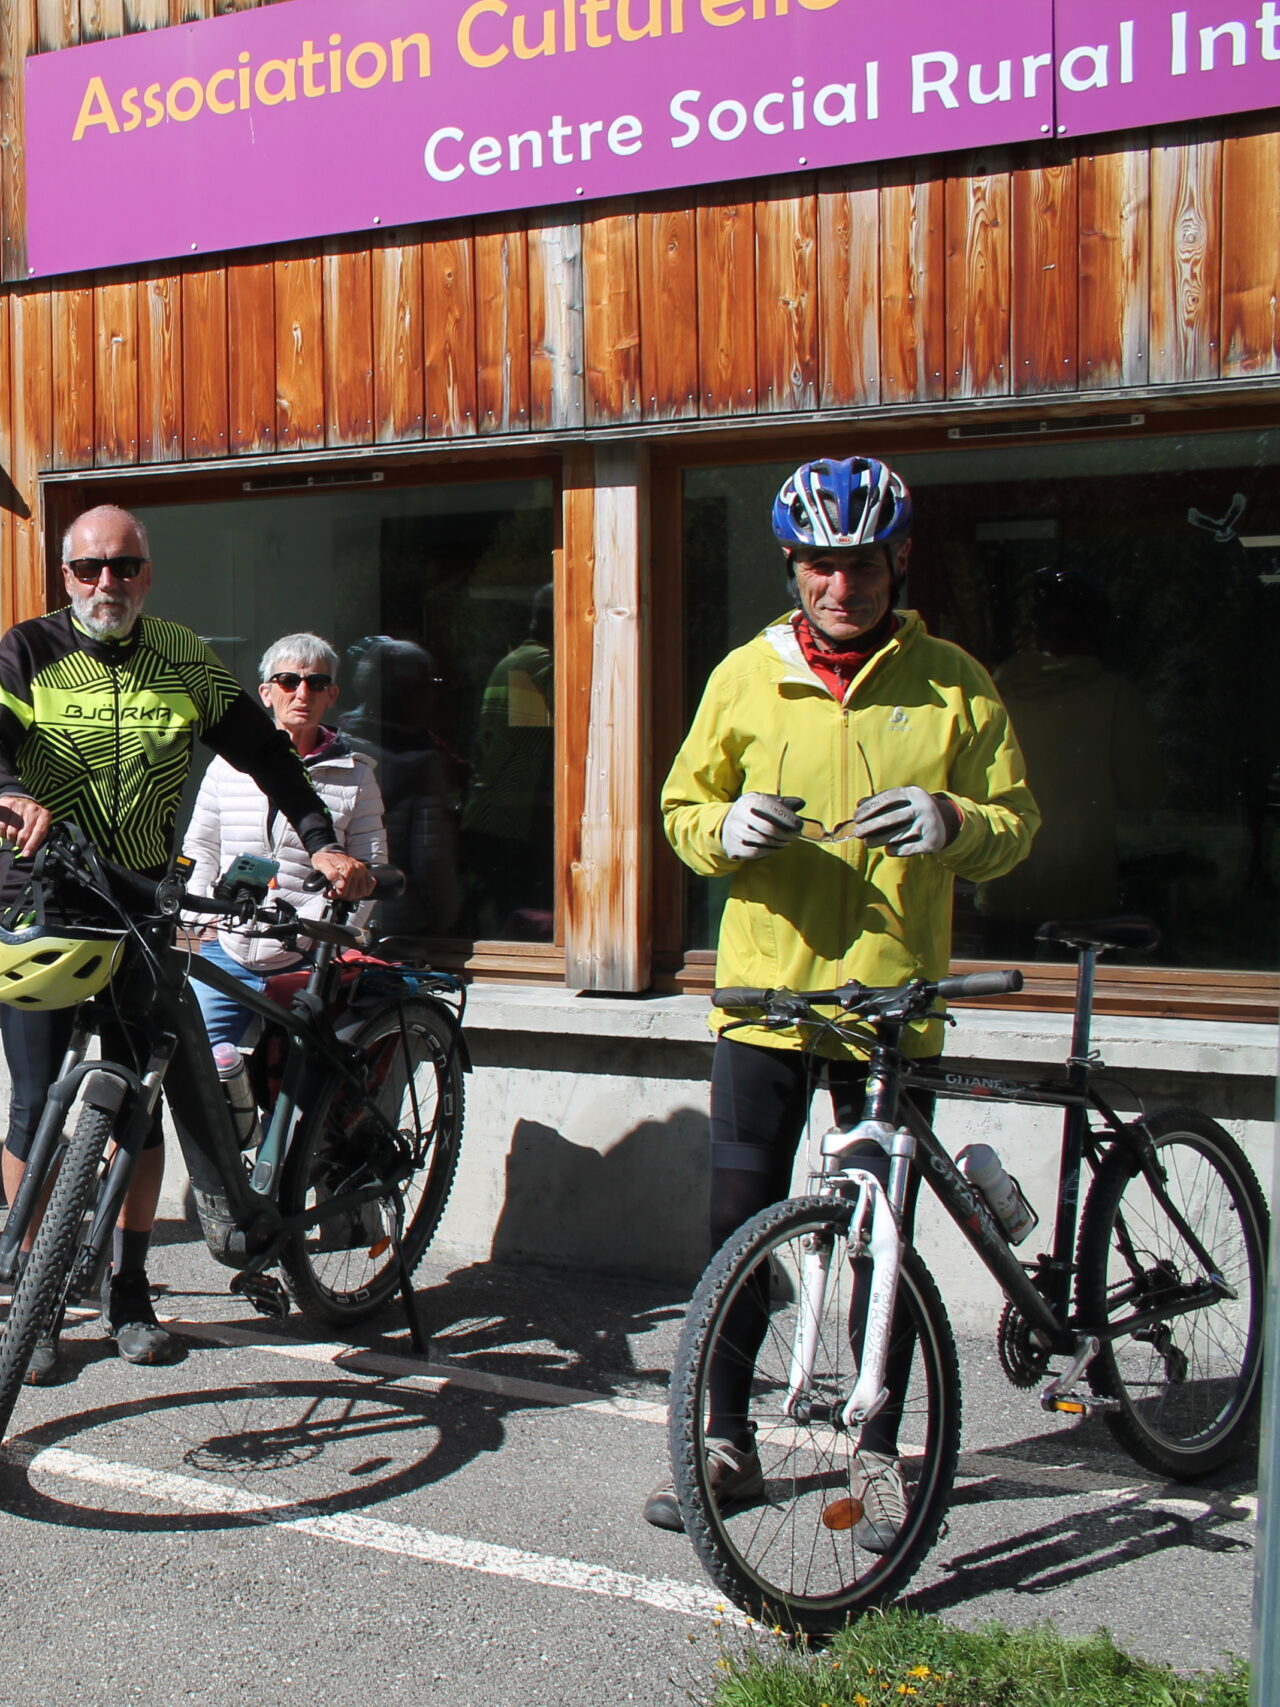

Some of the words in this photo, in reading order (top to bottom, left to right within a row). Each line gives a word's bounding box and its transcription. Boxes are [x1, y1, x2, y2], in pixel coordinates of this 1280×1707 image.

[71, 32, 432, 142] Association
[423, 114, 644, 182] Centre
[669, 60, 880, 149] Social
[910, 20, 1134, 114] Rural
[58, 703, 172, 722] BJÖRKA
